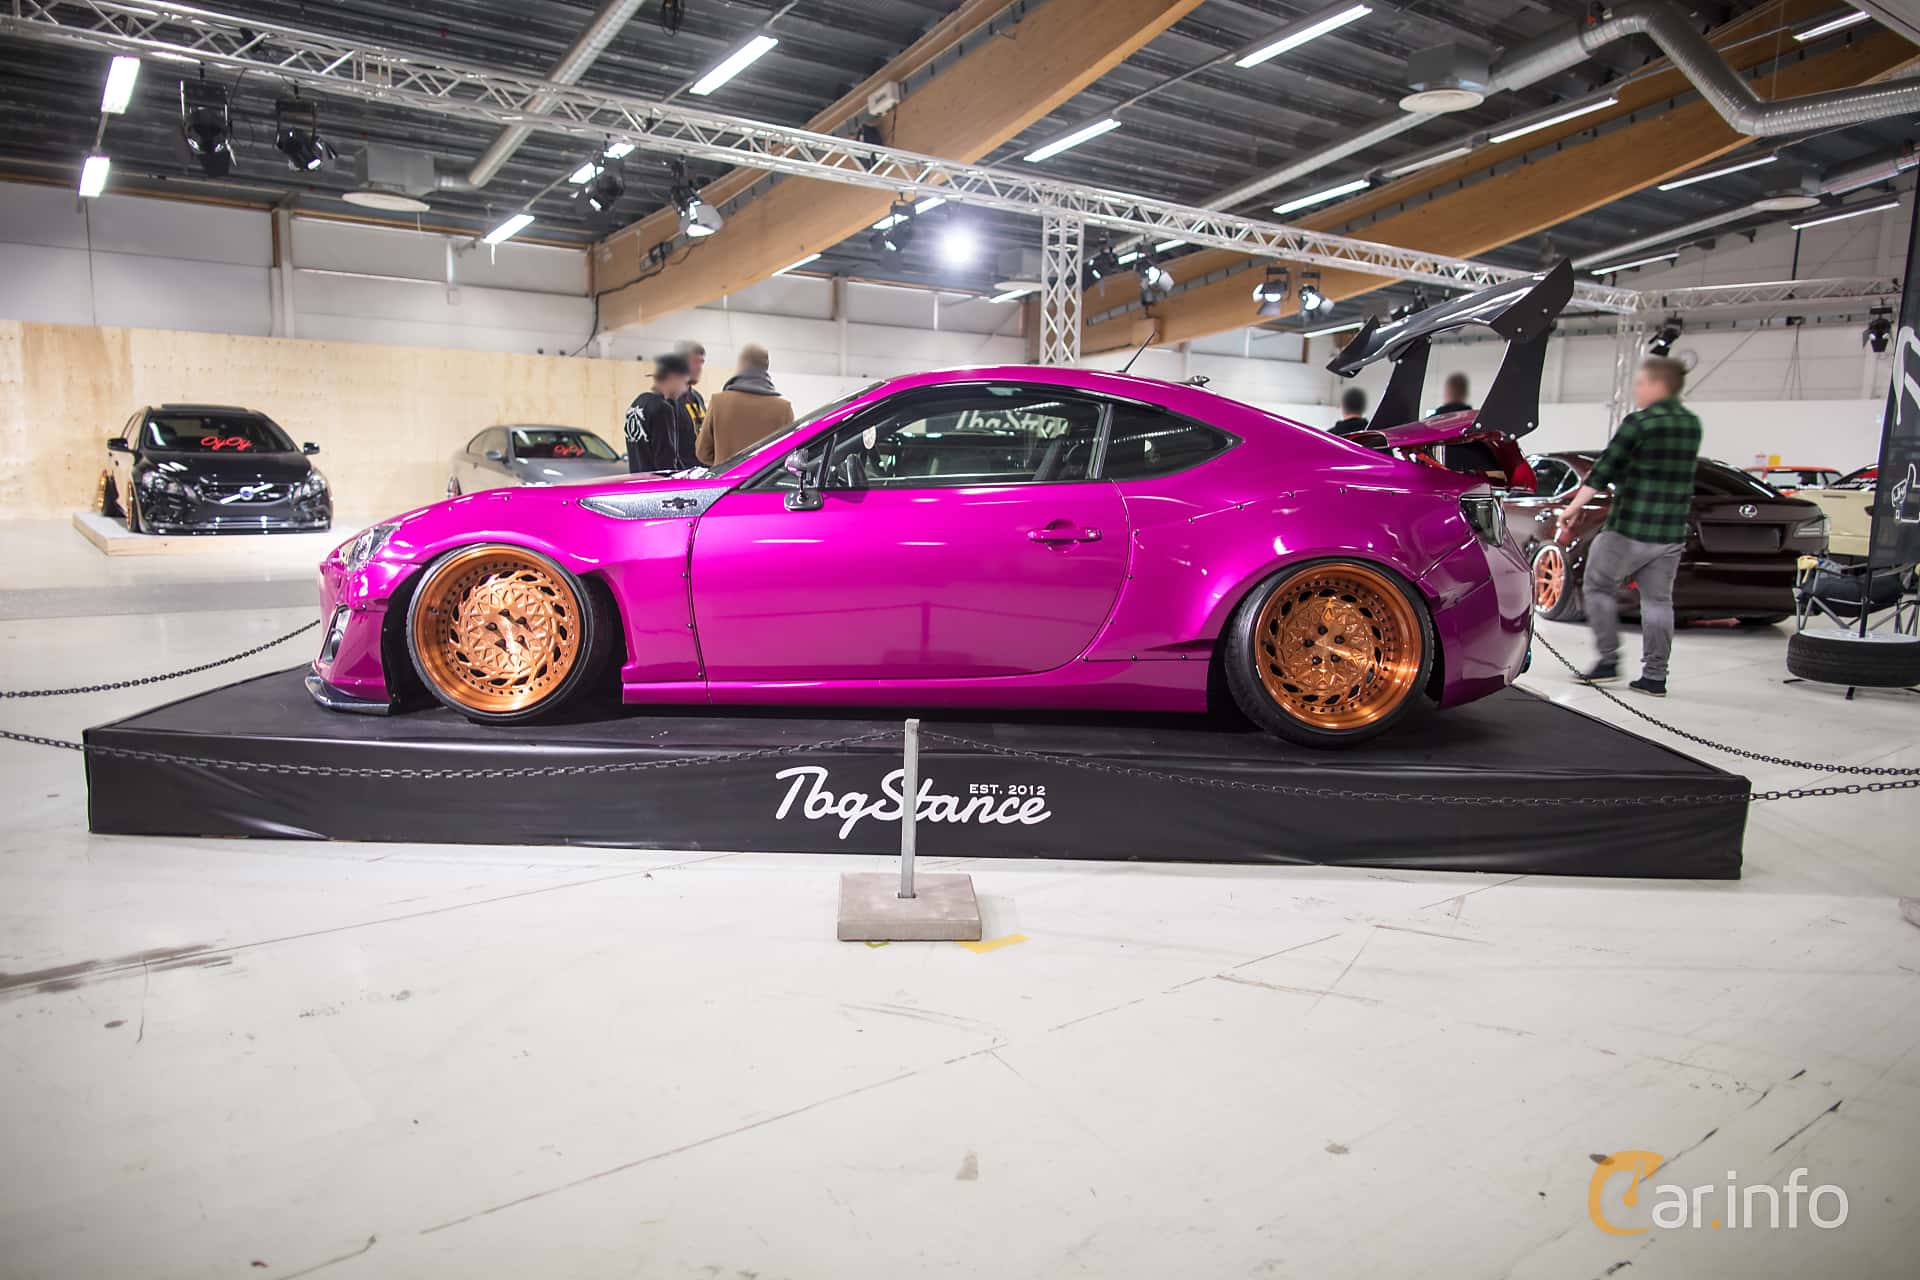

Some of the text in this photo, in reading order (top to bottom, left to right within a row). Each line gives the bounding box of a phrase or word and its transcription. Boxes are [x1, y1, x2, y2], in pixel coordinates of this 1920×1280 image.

[200, 436, 253, 451] OyOy
[969, 784, 1046, 796] EST. 2012
